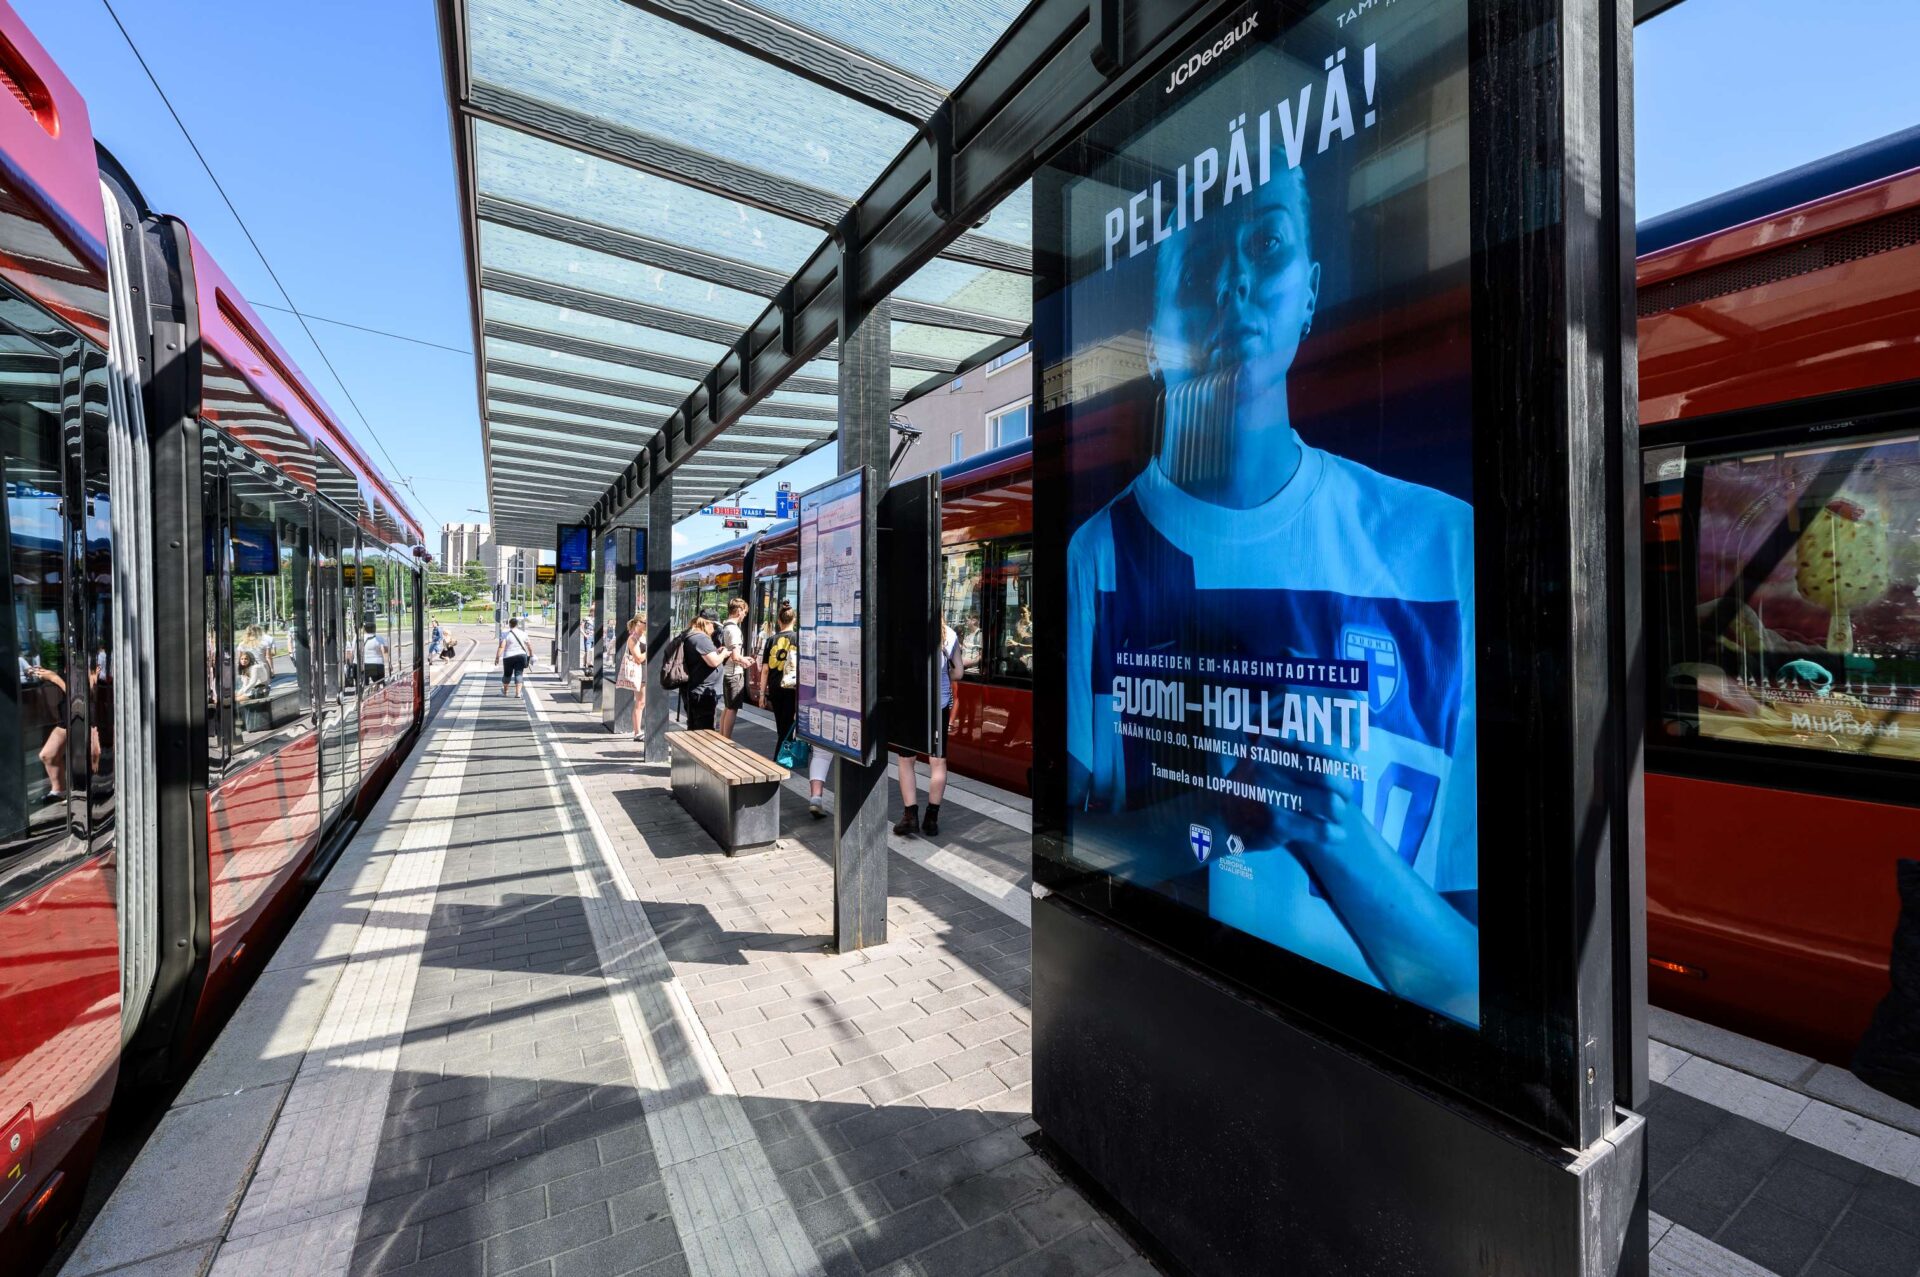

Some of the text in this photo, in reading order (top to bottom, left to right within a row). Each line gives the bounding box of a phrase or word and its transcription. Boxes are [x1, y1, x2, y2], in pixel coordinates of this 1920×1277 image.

[1336, 0, 1378, 28] TAM
[1165, 11, 1259, 94] JCDecaux
[1105, 42, 1377, 271] PELIPÄIVÄ!
[1116, 652, 1360, 684] HELMAREIDEN EM-KARSINTAOTTELU
[1113, 720, 1369, 782] TÄNÄÄN KLO 19.00, TAMMELAN STADION, TAMPERE
[1151, 762, 1302, 812] Tammela on LOPPUUNMYYTY!
